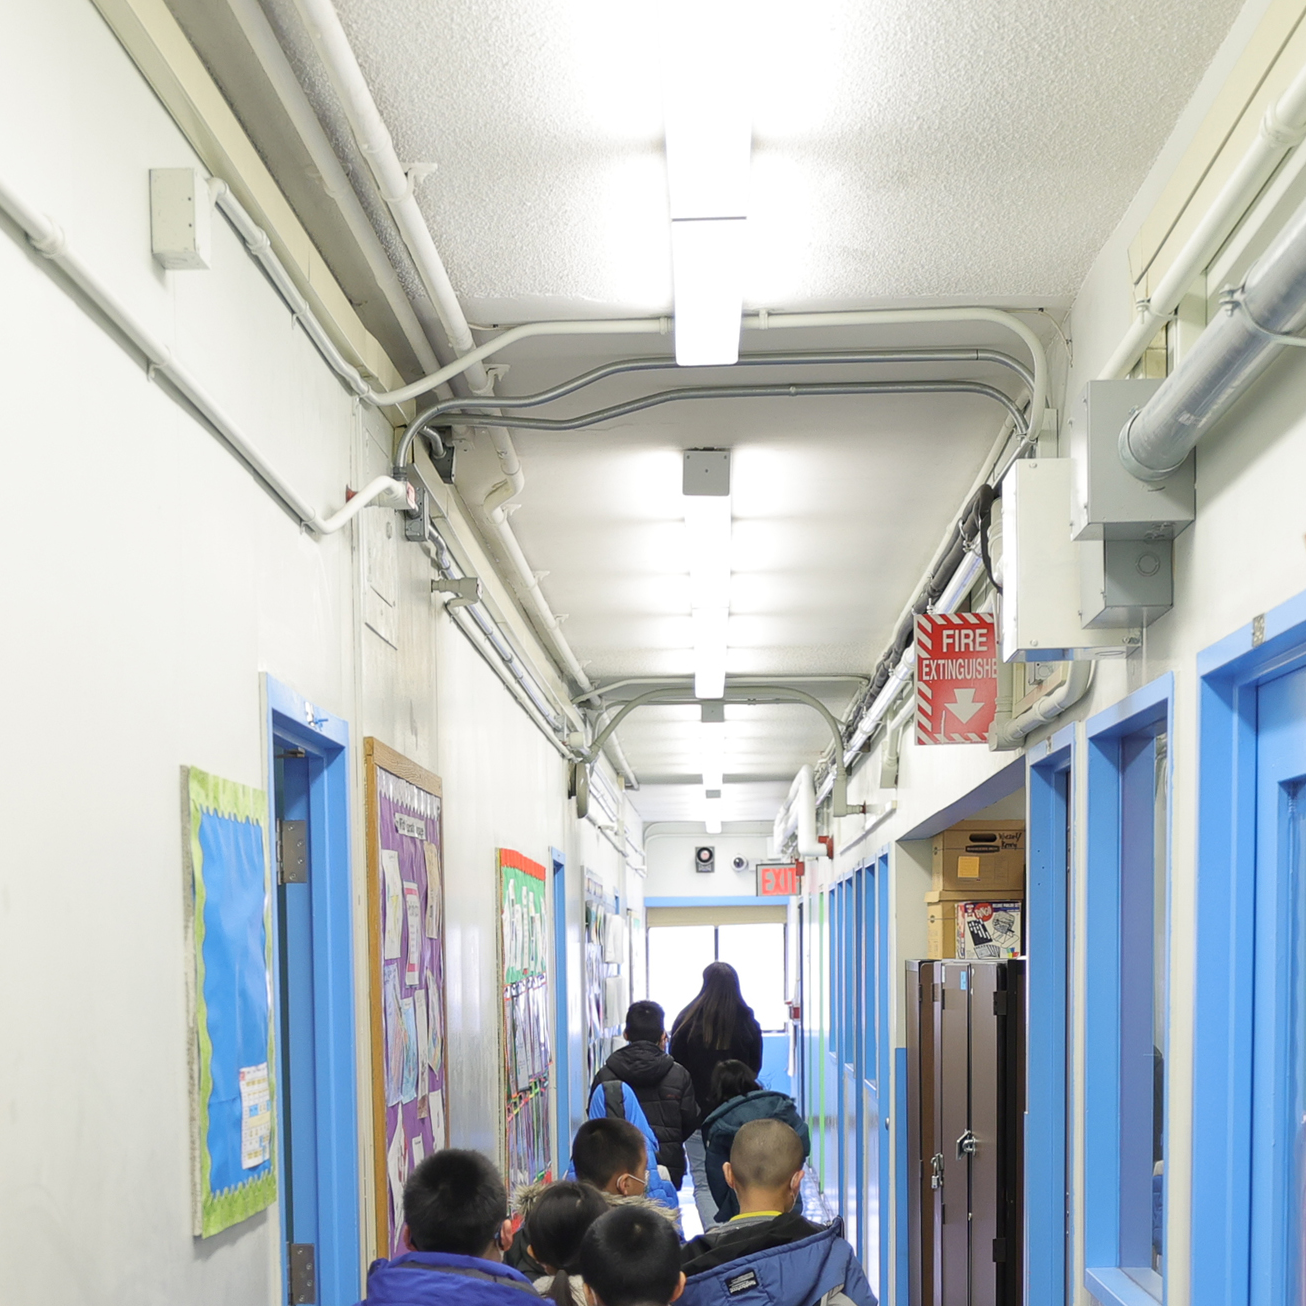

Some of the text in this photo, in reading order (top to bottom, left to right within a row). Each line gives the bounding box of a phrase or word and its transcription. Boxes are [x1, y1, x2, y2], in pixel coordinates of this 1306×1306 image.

[942, 629, 988, 652] FIRE
[922, 657, 997, 680] EXTINGUISHE
[761, 868, 798, 896] EXIT
